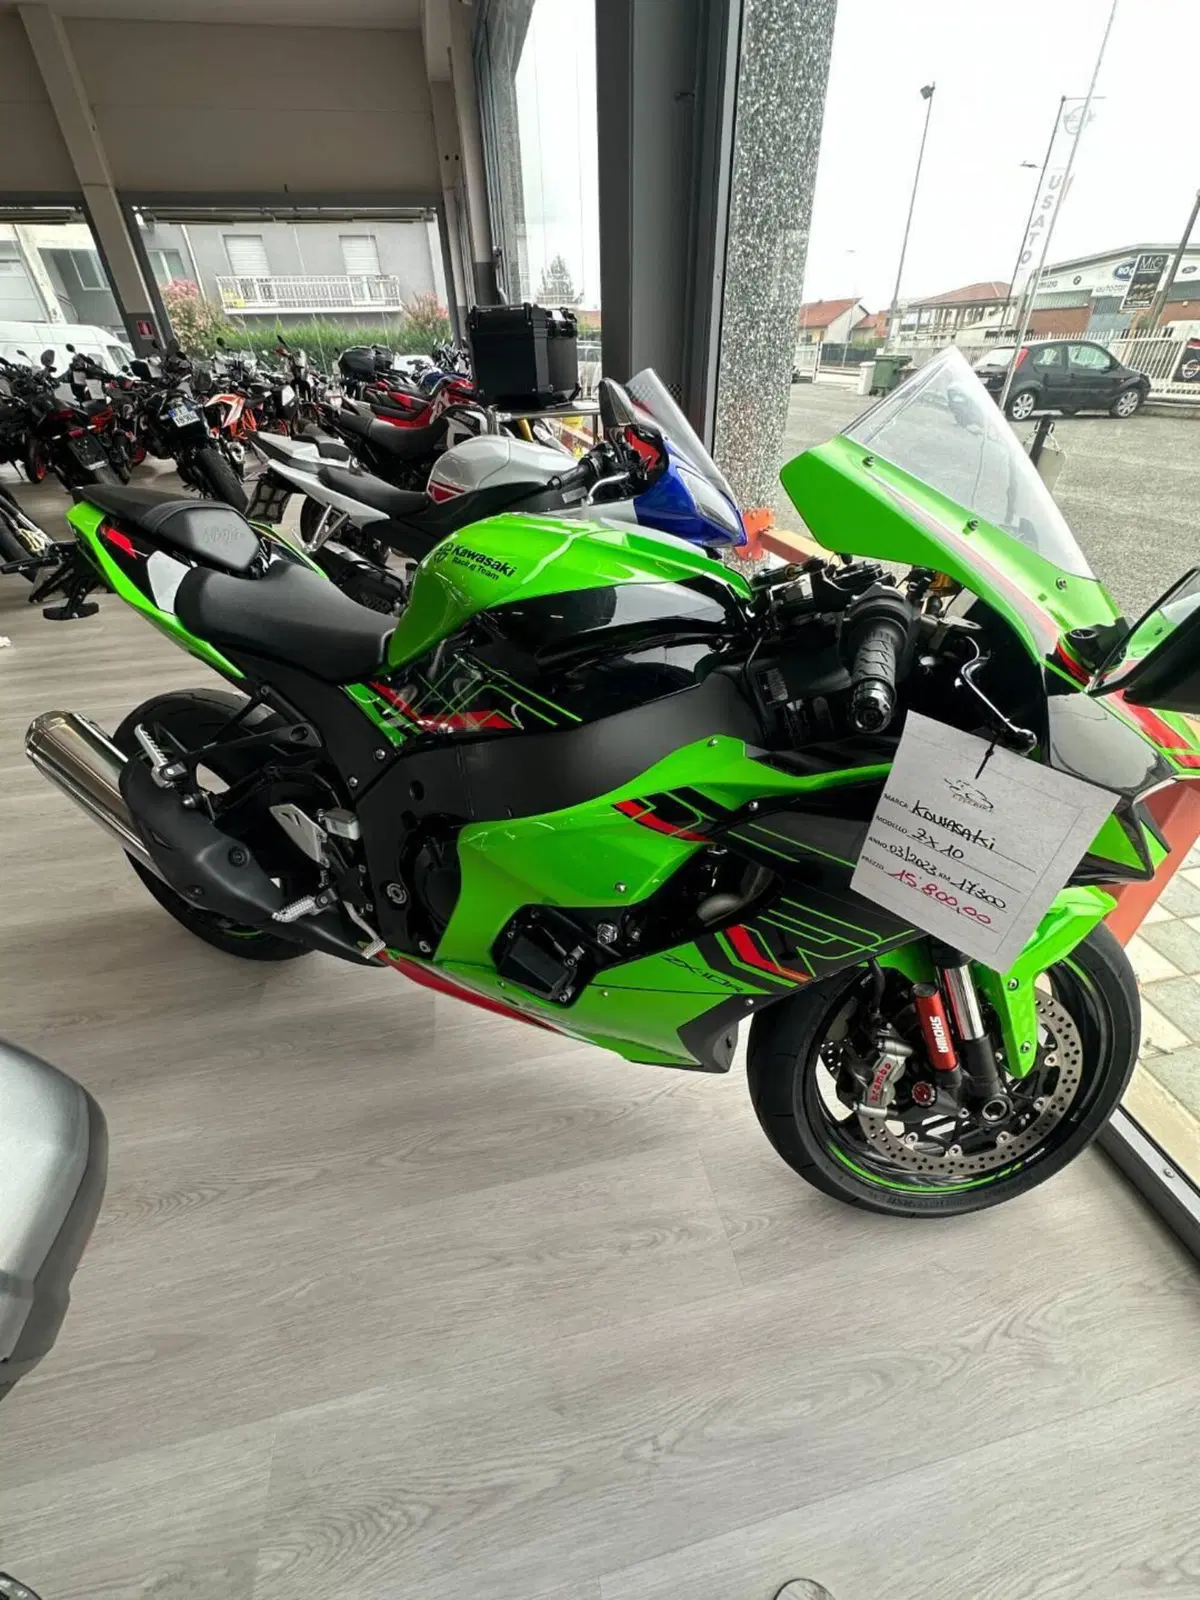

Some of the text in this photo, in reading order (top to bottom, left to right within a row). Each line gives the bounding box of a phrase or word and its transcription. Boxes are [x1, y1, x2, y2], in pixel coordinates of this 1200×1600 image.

[1020, 174, 1063, 264] USATO
[452, 545, 517, 577] Kawasaki
[452, 556, 500, 581] Racing Team
[884, 793, 908, 809] MARCA
[868, 836, 888, 849] ANNO
[875, 815, 908, 834] MODELLO
[940, 844, 964, 859] 10
[861, 855, 885, 870] PREZZO
[929, 1015, 950, 1053] SHOWA
[870, 1062, 892, 1104] brembo
